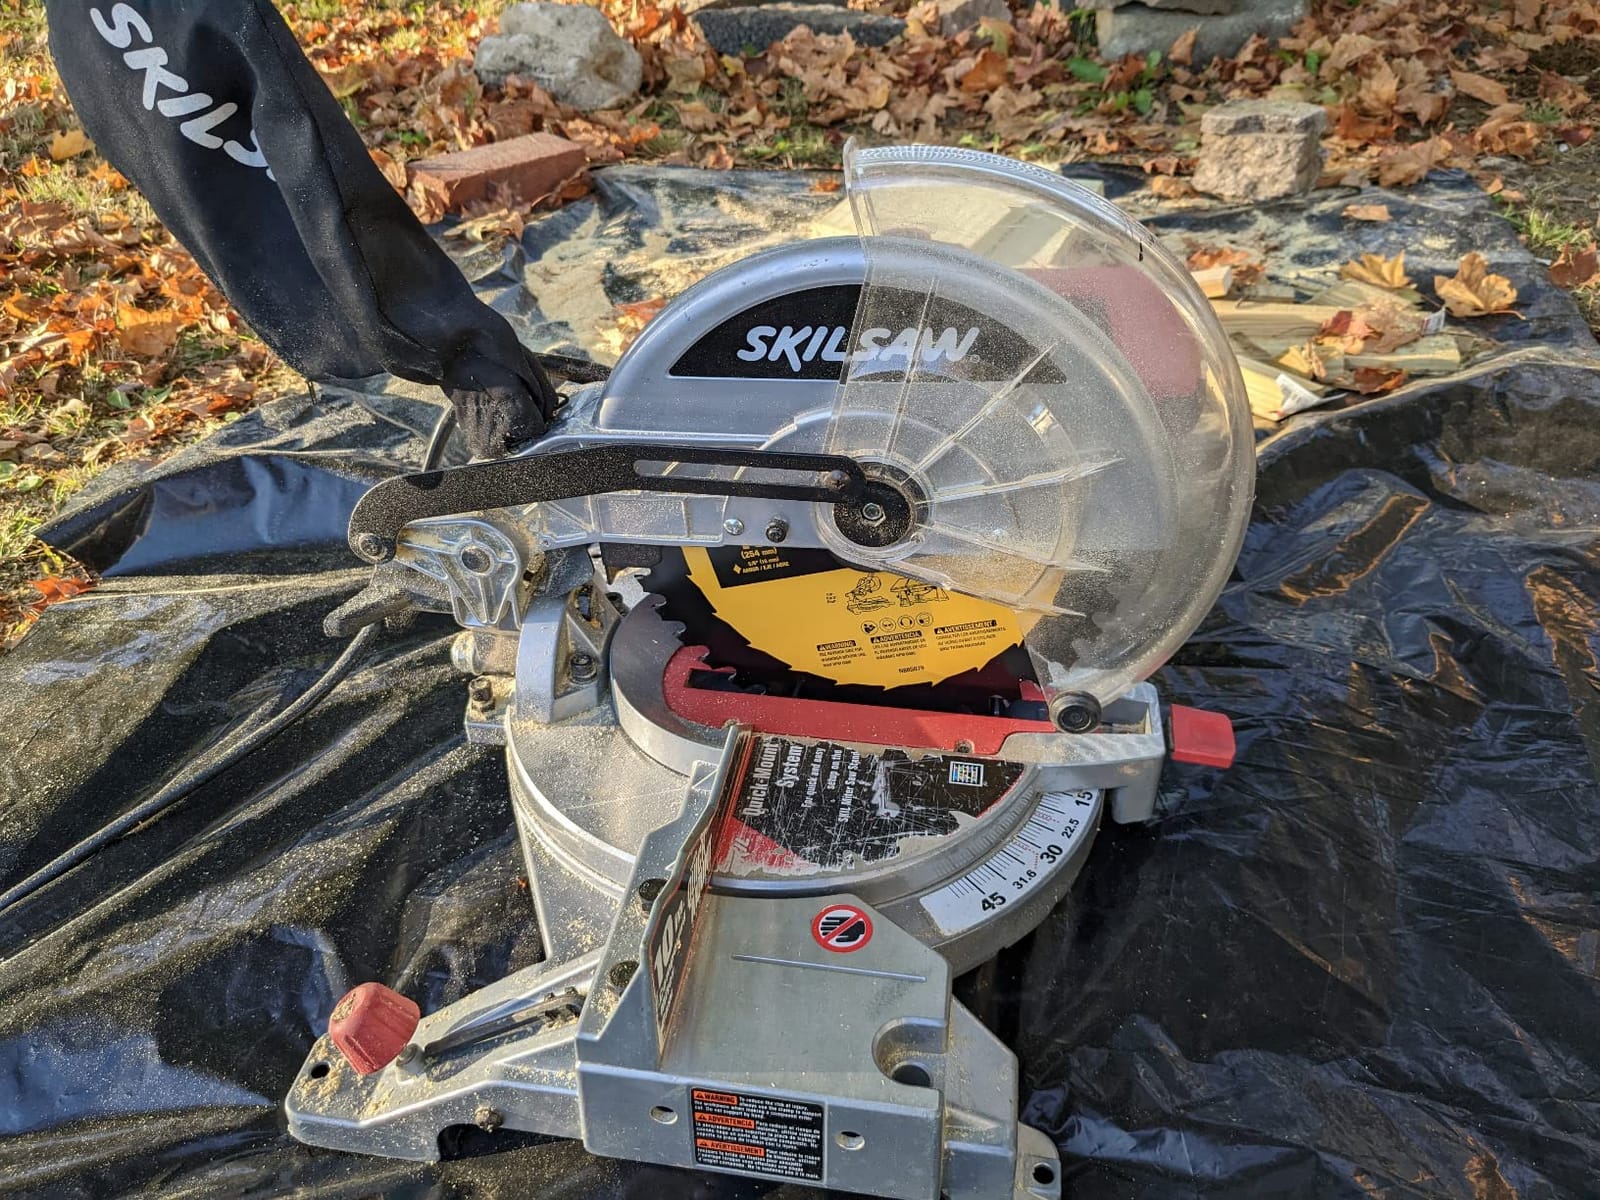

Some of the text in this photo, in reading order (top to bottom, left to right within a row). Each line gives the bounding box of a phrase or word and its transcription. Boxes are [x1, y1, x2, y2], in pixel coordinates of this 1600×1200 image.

[736, 325, 980, 372] SKILSAW
[776, 744, 804, 788] System
[827, 749, 843, 790] setup on the
[742, 739, 781, 817] Quick-Mount
[801, 747, 826, 808] For quick and easy
[838, 751, 860, 823] SKIL Miter Saw Stand
[1075, 791, 1094, 808] 15
[1061, 817, 1080, 839] 22.5
[1039, 844, 1063, 865] 30
[1012, 868, 1037, 890] 31.6
[981, 891, 1007, 912] 45
[654, 913, 674, 989] 10
[704, 1092, 736, 1104] WARNING
[708, 1115, 753, 1127] ADVERTENCIA
[710, 1141, 762, 1155] AVERTISSEMENT
